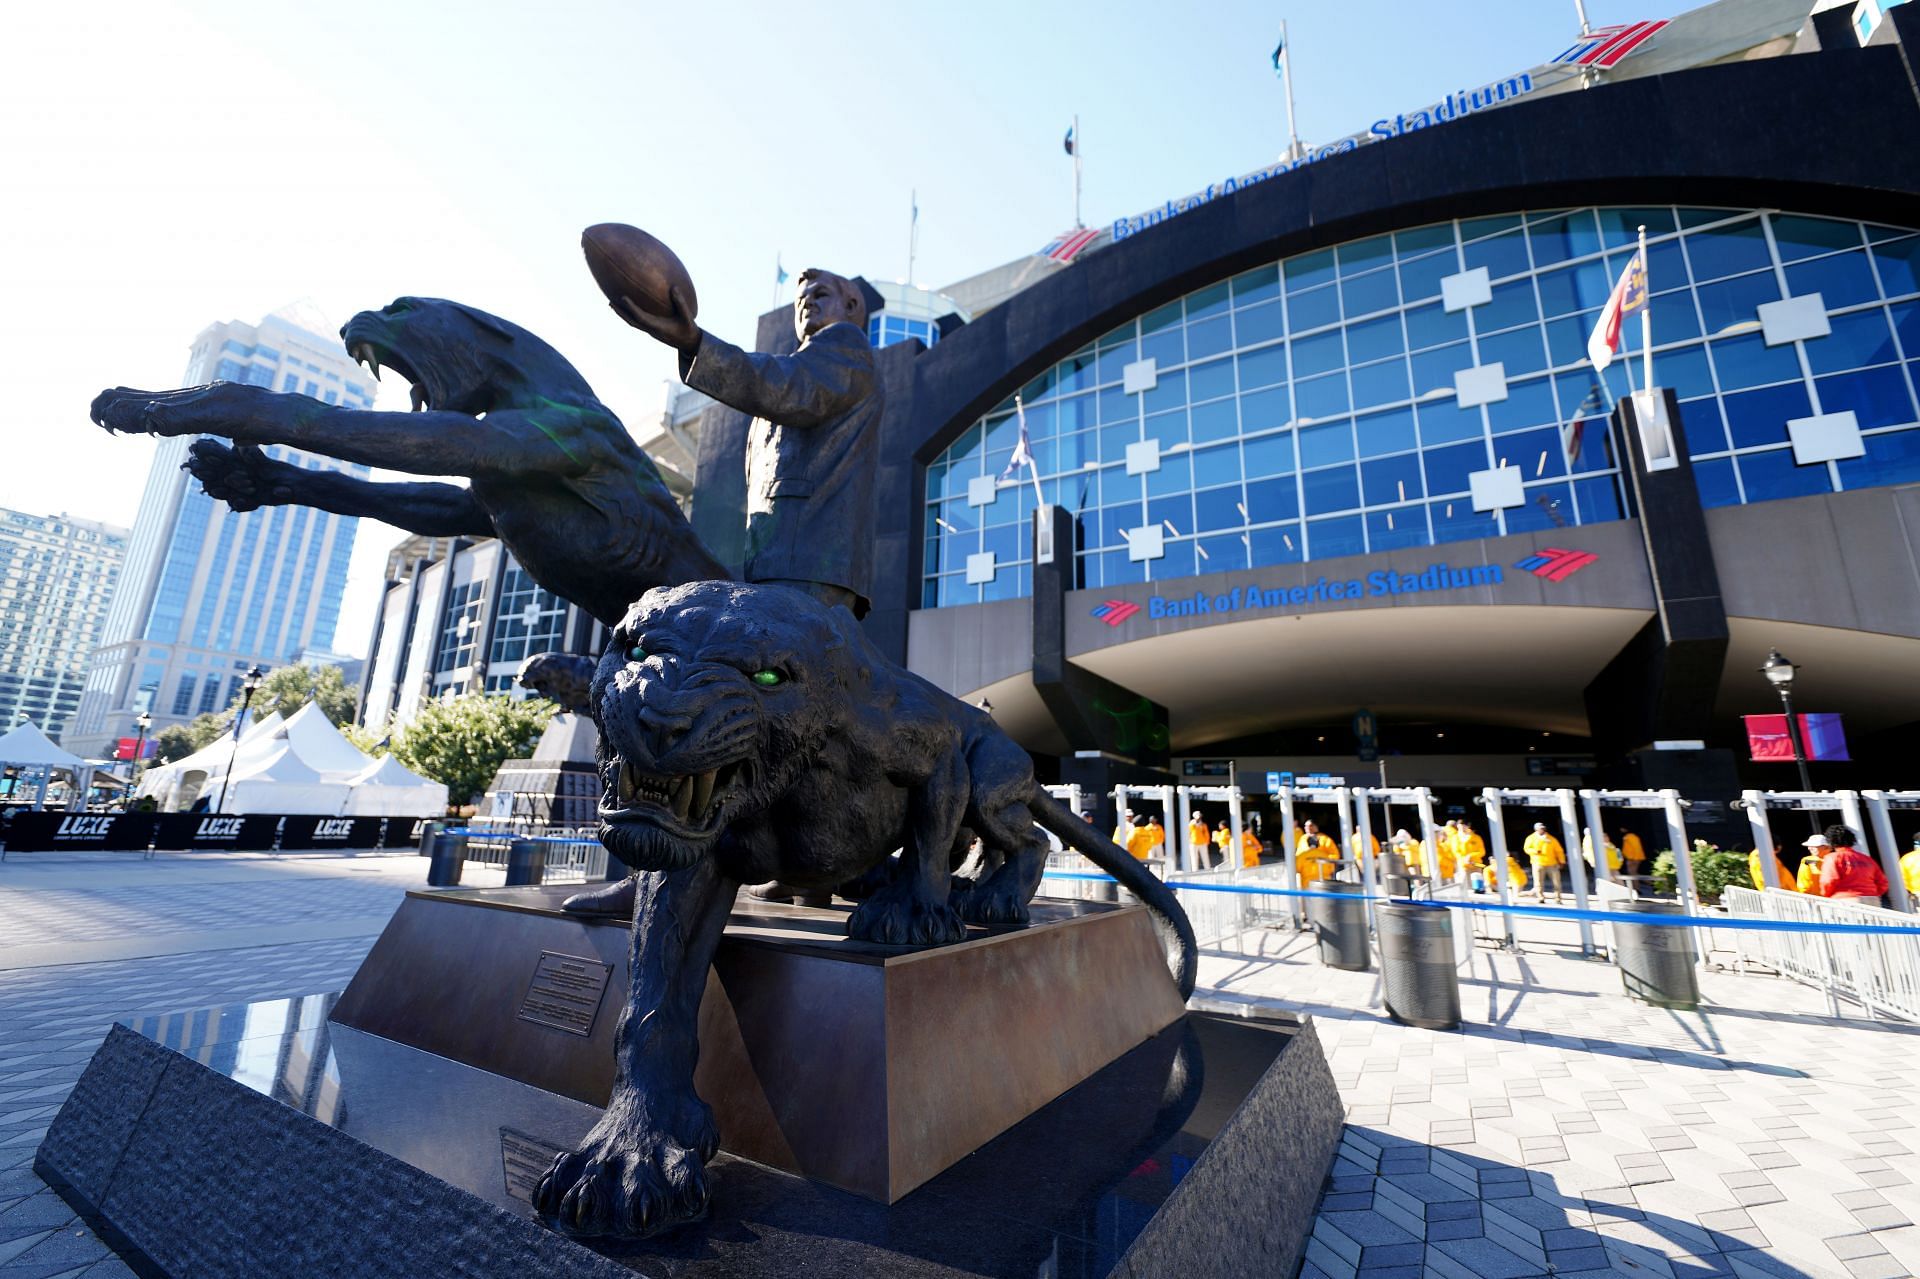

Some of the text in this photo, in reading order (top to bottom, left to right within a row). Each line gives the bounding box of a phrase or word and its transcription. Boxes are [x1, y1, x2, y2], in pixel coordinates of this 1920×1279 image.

[1113, 200, 1179, 241] Bank
[1187, 183, 1215, 209] of
[1370, 72, 1533, 139] Stadium
[1149, 563, 1504, 620] Bank of America Stadium
[57, 816, 116, 835] LUXE
[196, 818, 246, 836] LUXE
[313, 819, 356, 836] LUXE
